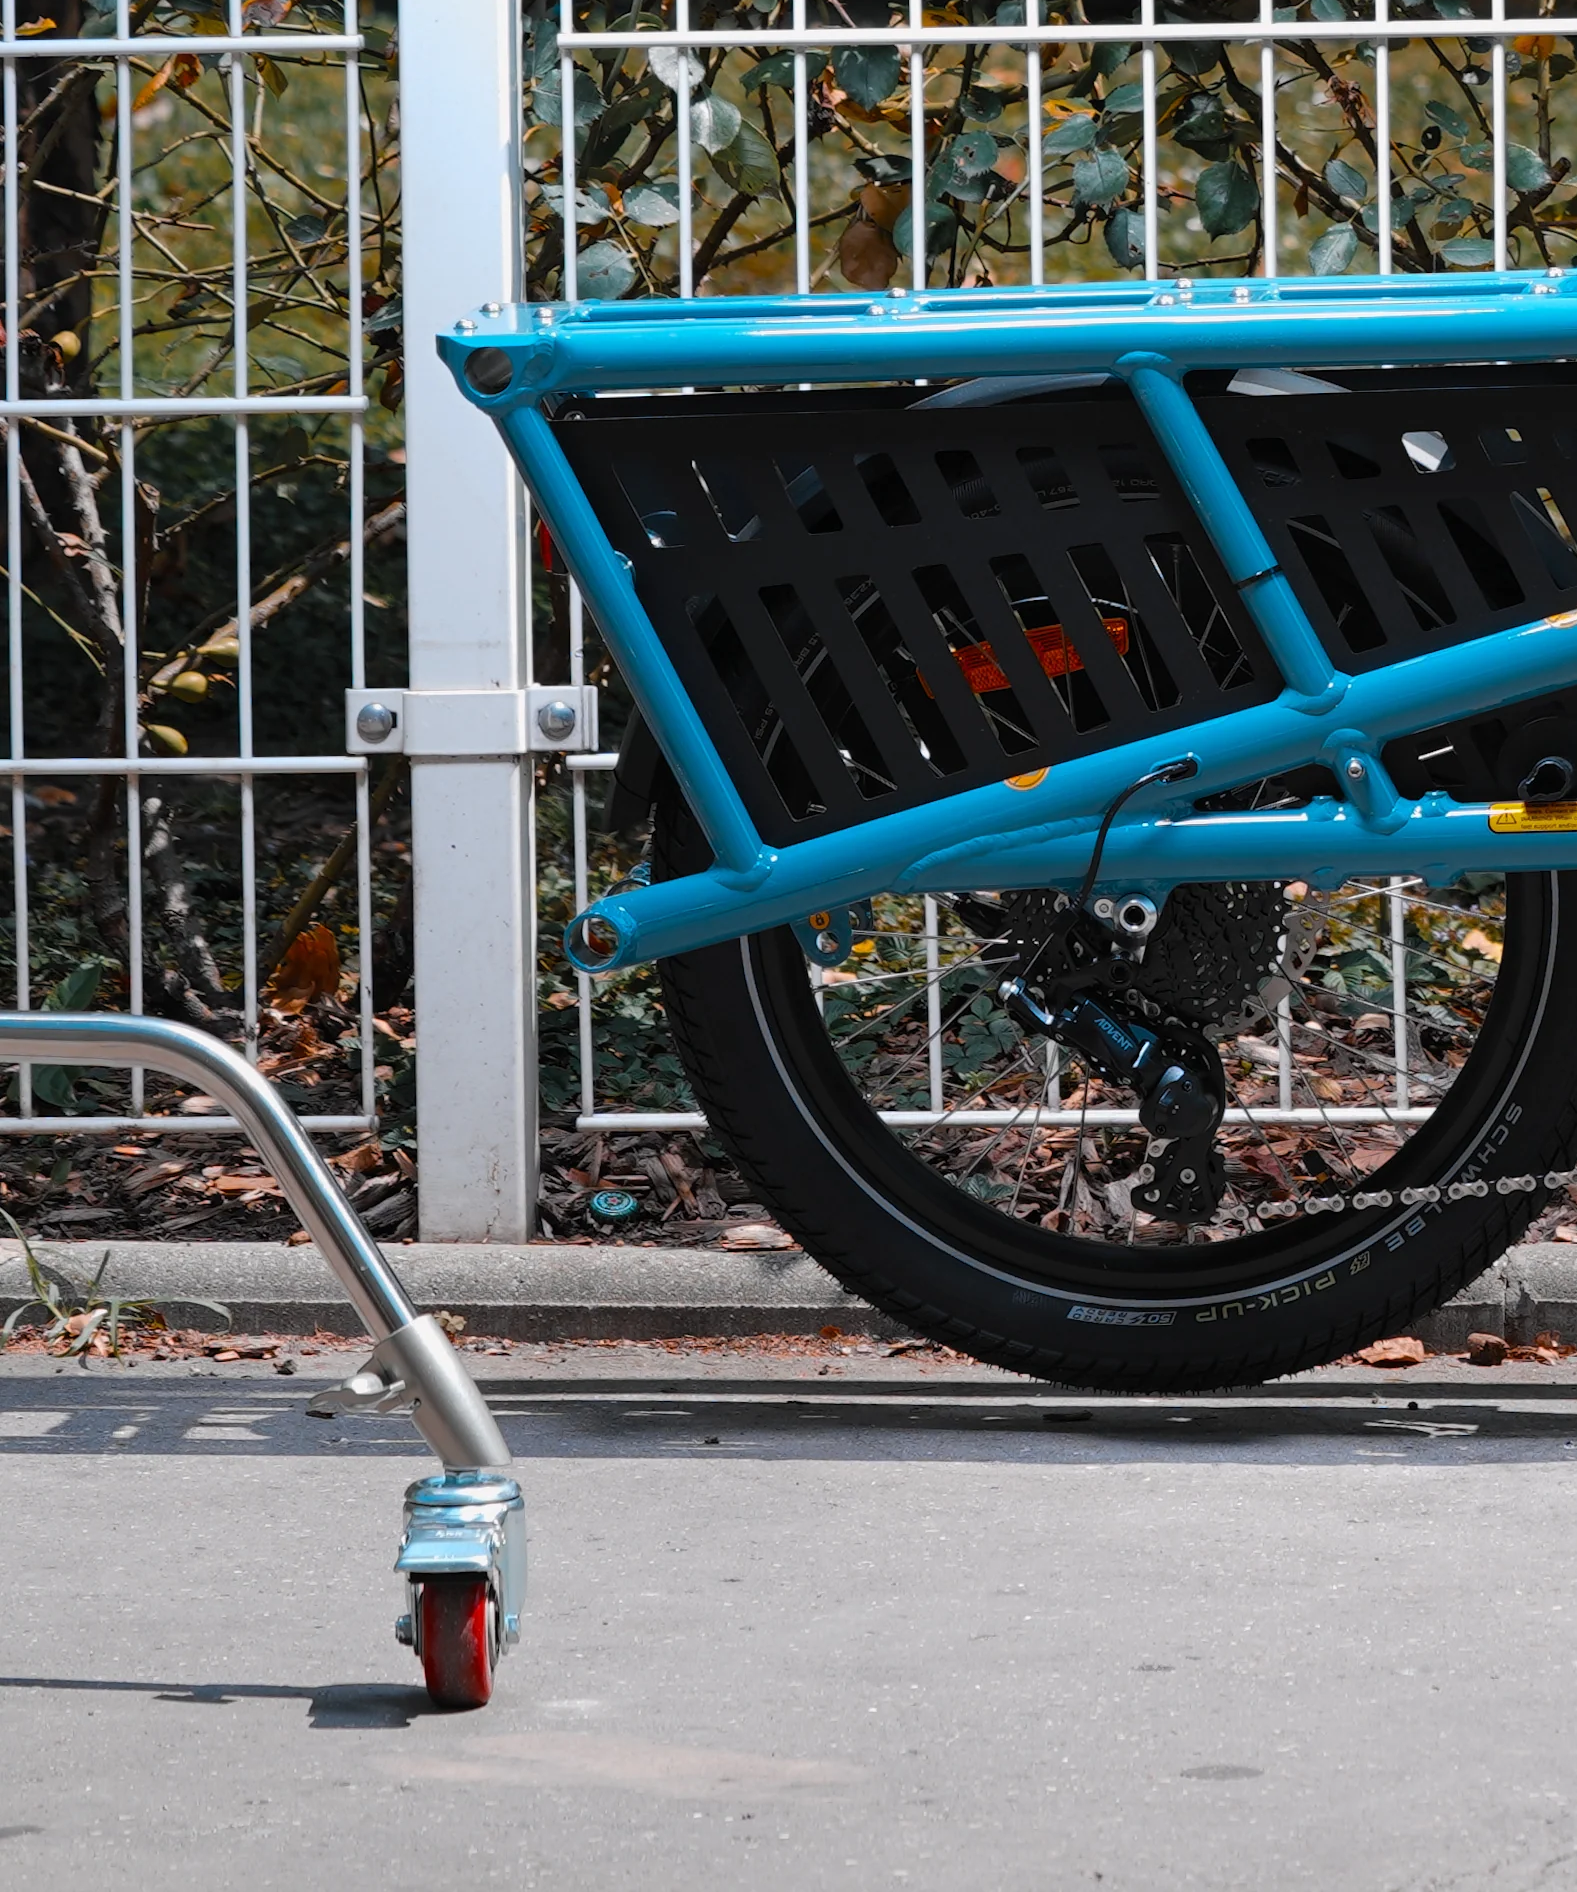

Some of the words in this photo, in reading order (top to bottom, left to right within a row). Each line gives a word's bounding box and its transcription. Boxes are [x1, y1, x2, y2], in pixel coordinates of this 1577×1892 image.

[1093, 1016, 1135, 1053] ADVENT
[1194, 1269, 1337, 1323] PICK-UP
[1070, 1310, 1126, 1326] CARGO
[1073, 1303, 1129, 1320] READY
[1145, 1311, 1174, 1324] 50
